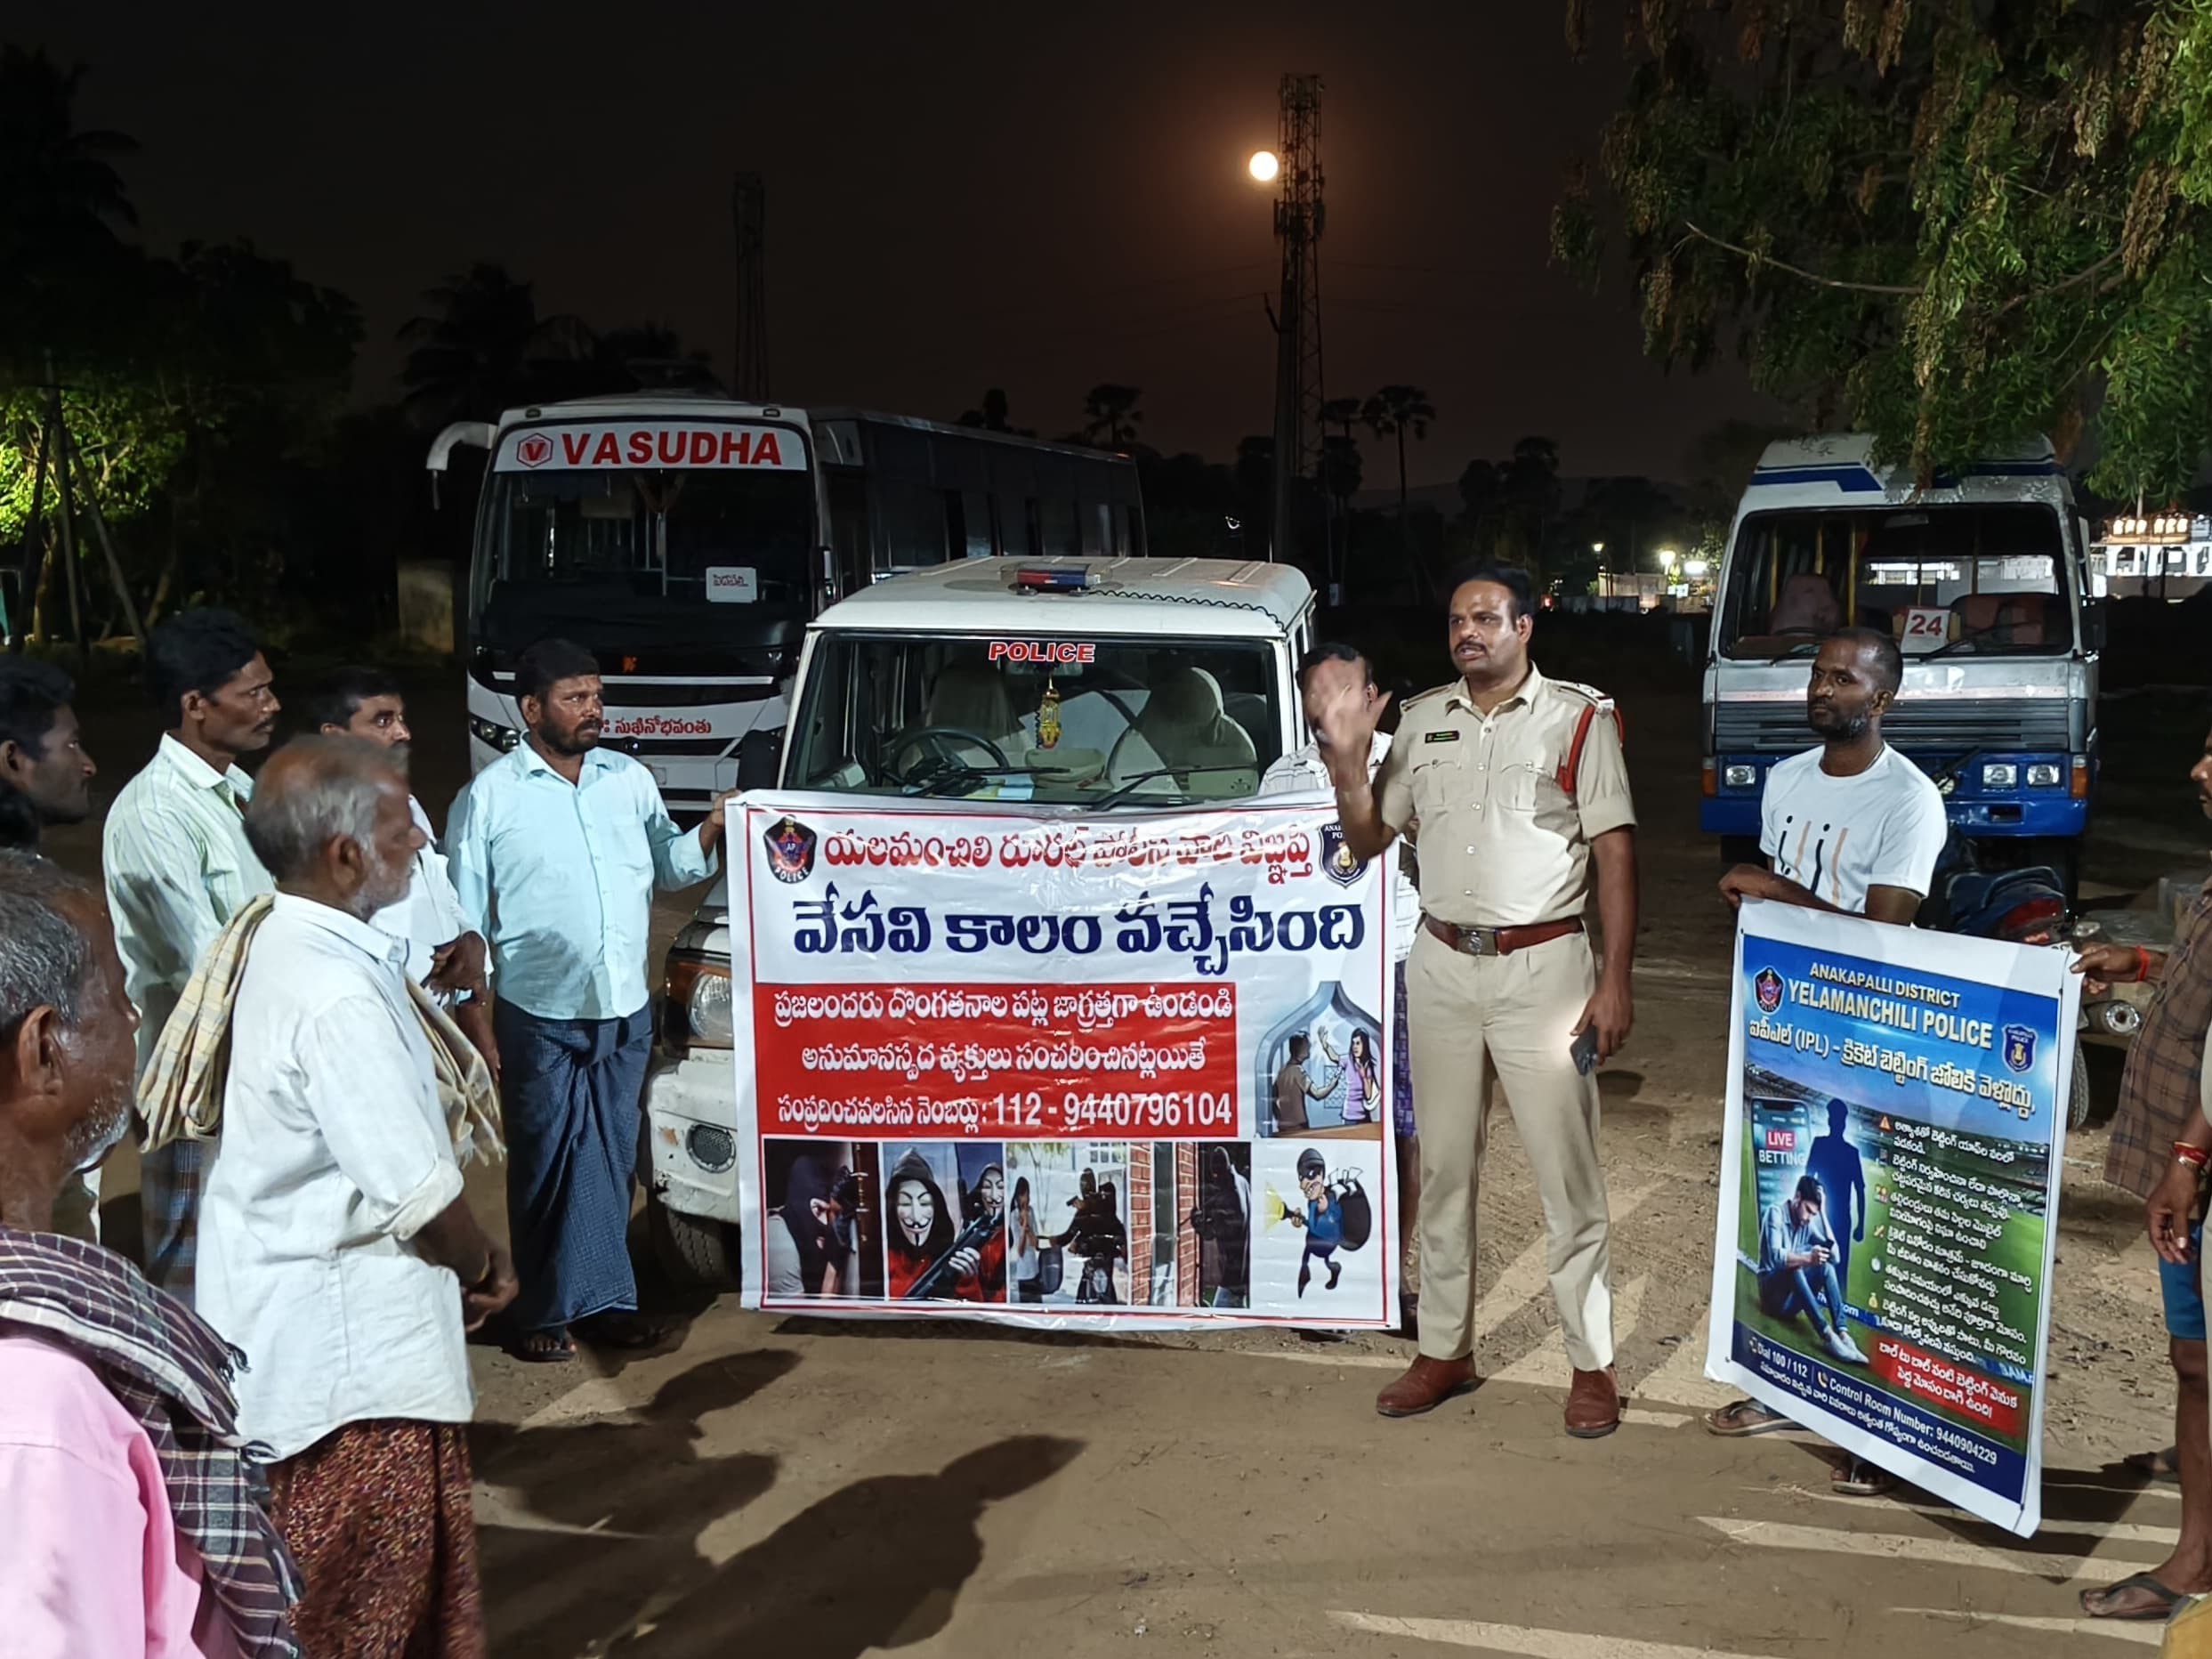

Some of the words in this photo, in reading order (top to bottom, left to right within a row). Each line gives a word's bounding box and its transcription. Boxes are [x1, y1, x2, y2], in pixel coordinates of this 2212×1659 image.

[561, 432, 781, 465] VASUDHA
[1909, 613, 1943, 635] 24
[989, 641, 1096, 662] POLICE
[824, 829, 993, 868] యలమంచిలి
[1175, 831, 1232, 866] వారి
[774, 867, 809, 883] POLICE
[792, 881, 931, 954] వేసవి
[945, 911, 1102, 954] కాలం
[1114, 881, 1365, 975] వచ్చేసింది
[1809, 962, 1892, 993] ANAKAPALLI
[1894, 980, 1960, 1008] DISTRICT
[774, 990, 883, 1027] ప్రజలందరు
[888, 988, 1007, 1019] దొంగతనాల
[1012, 989, 1049, 1026] పట్ల
[1054, 989, 1138, 1028] జాగ్రత్తగా
[1143, 985, 1232, 1018] ఉండండి
[1788, 978, 1917, 1030] YELAMANCHILI
[1922, 1009, 1992, 1048] POLICE
[940, 1042, 1012, 1082] వ్యక్తులు
[1016, 1036, 1207, 1079] సంచరించినట్లయితే
[1749, 1015, 1793, 1044] ఐపీఎల్
[1795, 1028, 1829, 1057] (IPL)
[1841, 1038, 1878, 1066] క్రికెట్
[1879, 1048, 1928, 1083] బెట్టింగ్
[1930, 1063, 1975, 1092] జోలికి
[778, 1094, 914, 1132] సంప్రదించవలసిన
[993, 1092, 1042, 1126] 112
[1064, 1092, 1231, 1126] 9440796104
[1768, 1131, 1793, 1146] LIVE
[1772, 1350, 1786, 1367] 100
[1792, 1361, 1807, 1377] 112
[1829, 1377, 1862, 1403] Control
[1864, 1393, 1891, 1417] Room
[1893, 1406, 1933, 1436] Number:
[1936, 1426, 1997, 1464] 9440904229
